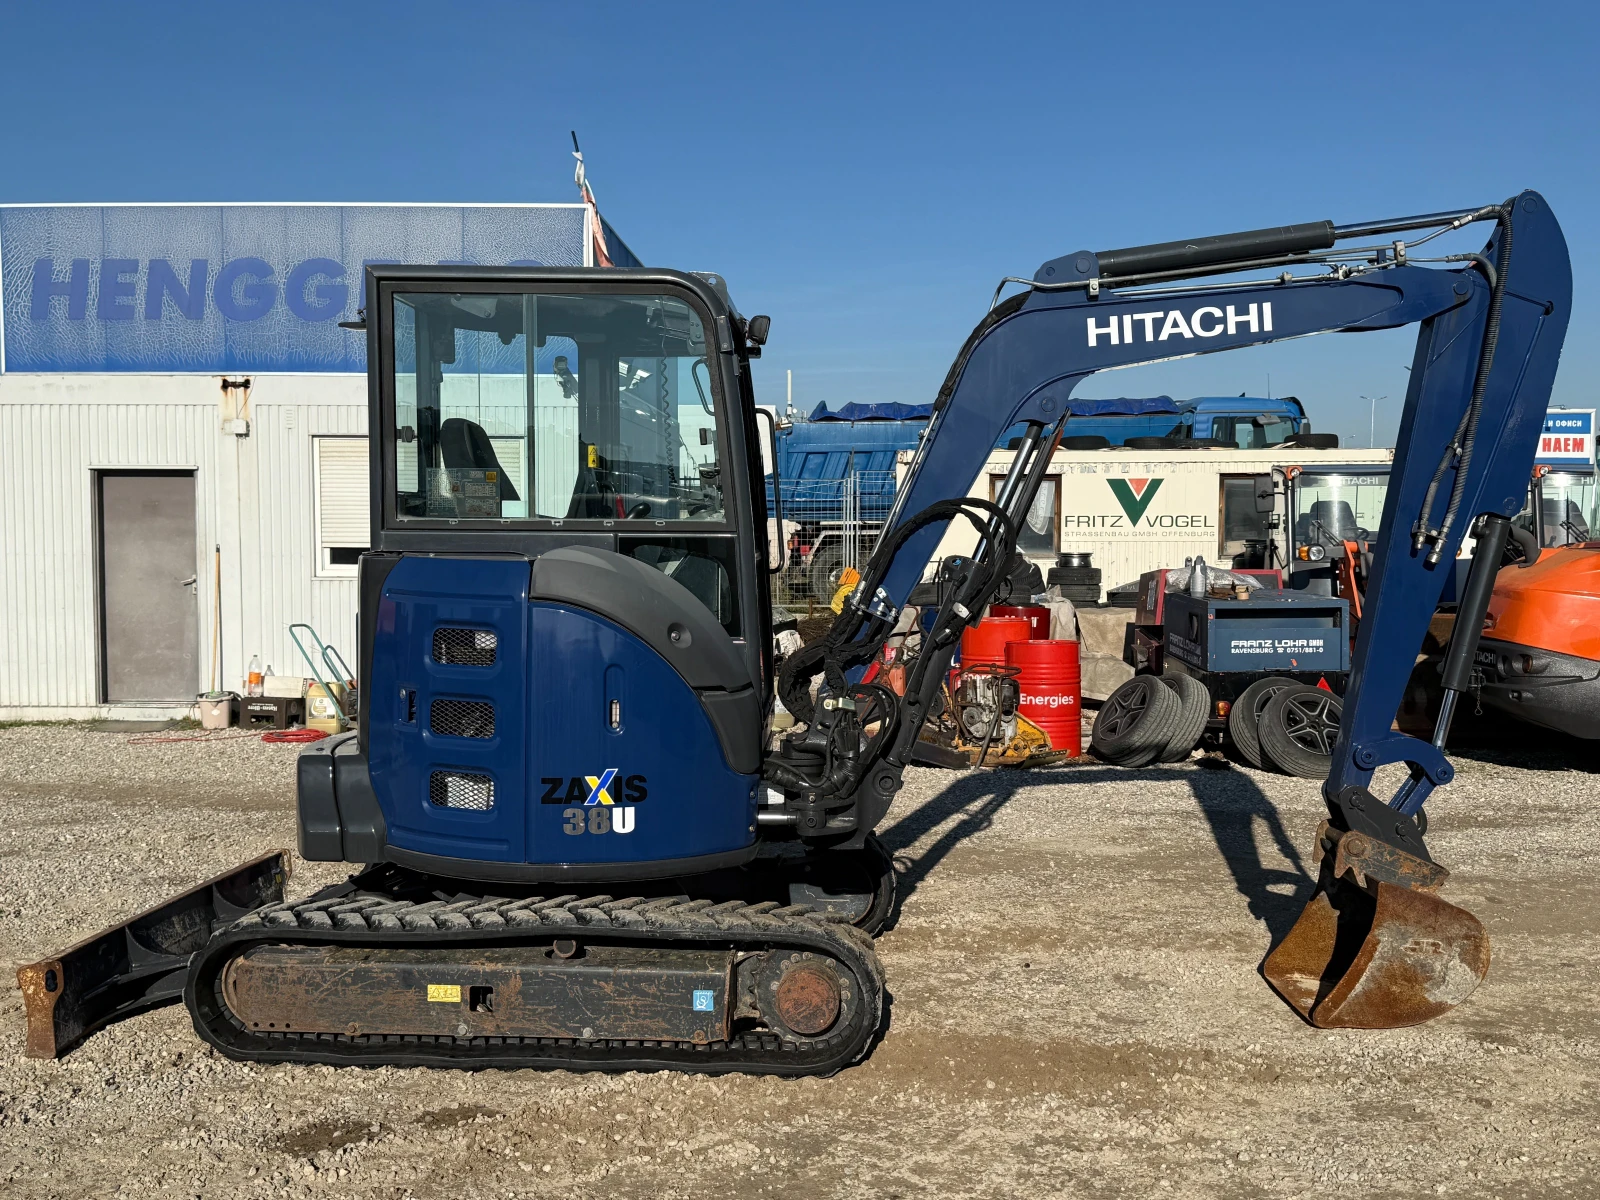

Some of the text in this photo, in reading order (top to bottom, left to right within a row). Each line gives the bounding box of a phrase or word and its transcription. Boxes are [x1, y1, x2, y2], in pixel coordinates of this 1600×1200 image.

[31, 257, 365, 322] HENGG
[1086, 302, 1273, 347] HITACHI
[1555, 419, 1582, 427] ОФИСИ
[1542, 437, 1585, 453] НАЕМ
[1342, 477, 1379, 485] ITACHI
[1064, 515, 1215, 528] FRITZ VOGEL
[1231, 640, 1273, 648] FRANZ
[1275, 639, 1307, 647] LOHR
[1475, 651, 1497, 665] TACHI
[1020, 693, 1074, 708] Energies
[541, 768, 648, 805] ZAXIS
[563, 806, 636, 836] 38U
